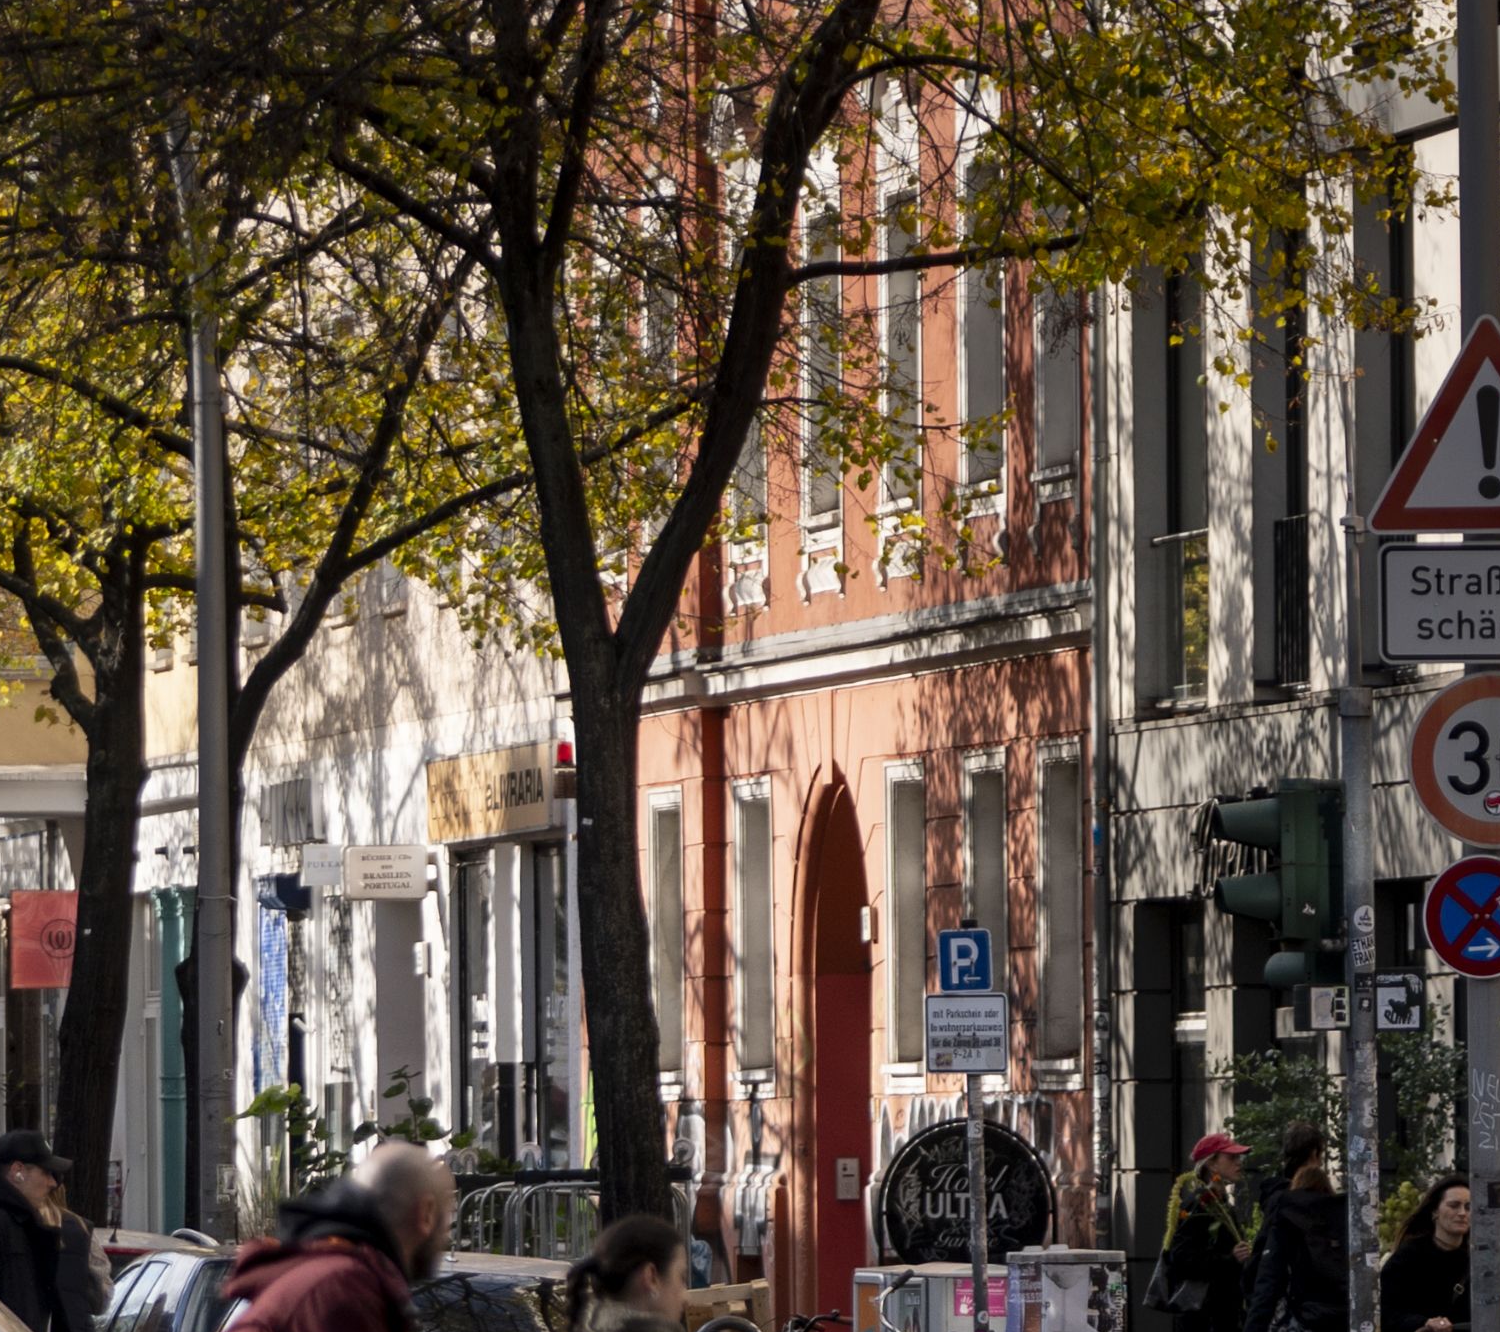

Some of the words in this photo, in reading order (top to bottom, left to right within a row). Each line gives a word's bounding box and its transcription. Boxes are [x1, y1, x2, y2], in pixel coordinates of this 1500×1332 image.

[362, 872, 412, 880] BRASILIEN
[362, 881, 412, 890] PORTUGAL
[926, 1164, 1010, 1192] Hoel
[925, 1192, 1009, 1220] ULTA
